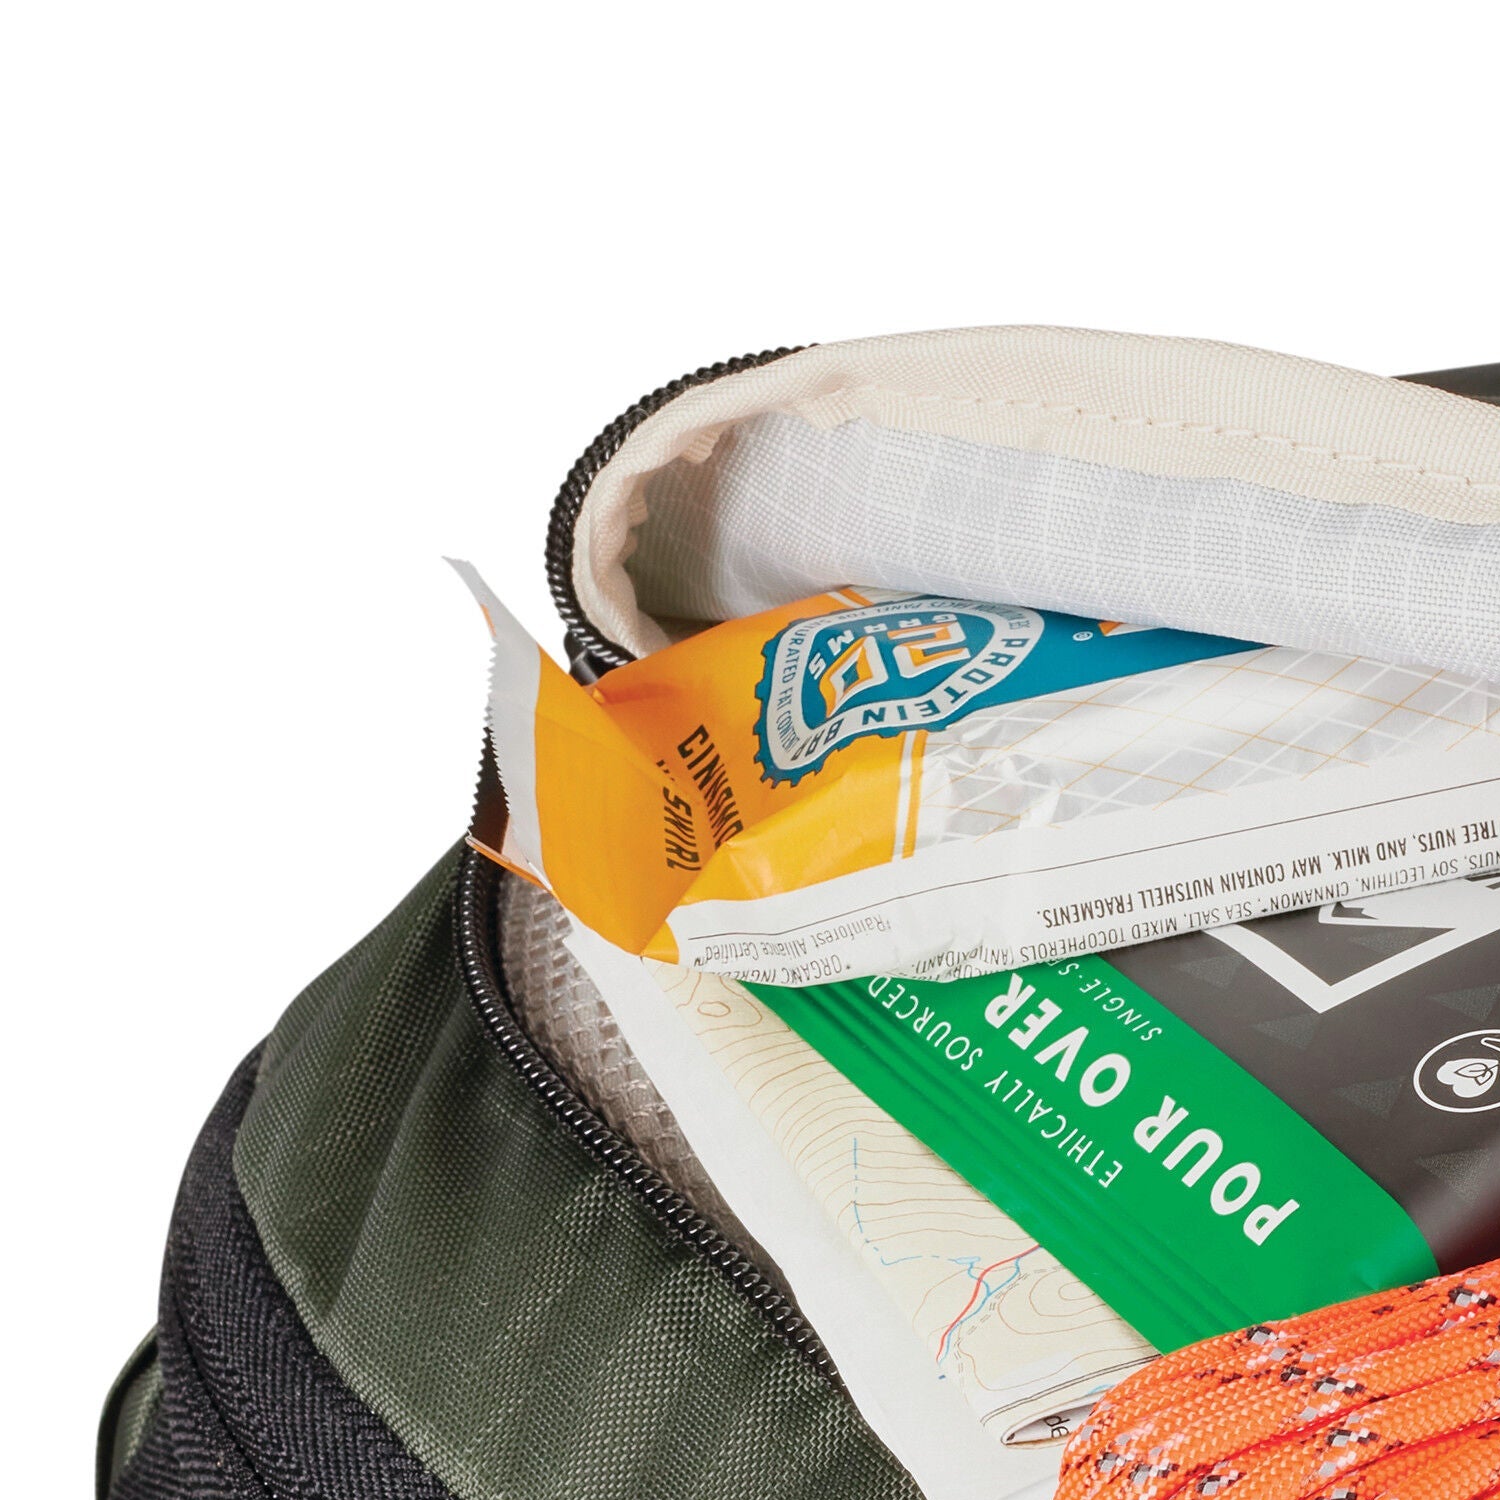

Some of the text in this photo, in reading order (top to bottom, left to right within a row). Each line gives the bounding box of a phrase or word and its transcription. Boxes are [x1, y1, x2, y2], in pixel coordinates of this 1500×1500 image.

[808, 613, 957, 680] GRAMS
[819, 621, 971, 718] 20
[861, 638, 1029, 725] PROTEIN
[777, 687, 793, 711] FAT
[662, 786, 702, 871] SWIRL
[1411, 827, 1457, 853] NUTS,
[1460, 819, 1497, 843] TREE
[1326, 845, 1371, 871] MILK.
[1375, 837, 1408, 861] AND
[1218, 863, 1286, 892] CONTAIN
[1289, 855, 1322, 878] MAY
[1354, 864, 1425, 893] LECITHIN,
[1429, 857, 1459, 878] SOY
[1137, 876, 1214, 909] NUTSHELL
[1036, 892, 1133, 929] FRAGMENTS.
[1182, 907, 1221, 929] SALT,
[1224, 900, 1252, 922] SEA
[1129, 916, 1178, 941] MIXED
[760, 939, 807, 958] Alliance
[1018, 927, 1125, 962] TOCOPHEROLS
[868, 975, 1123, 1188] ETHICALLY SOURCED
[984, 972, 1300, 1247] POUR OVER
